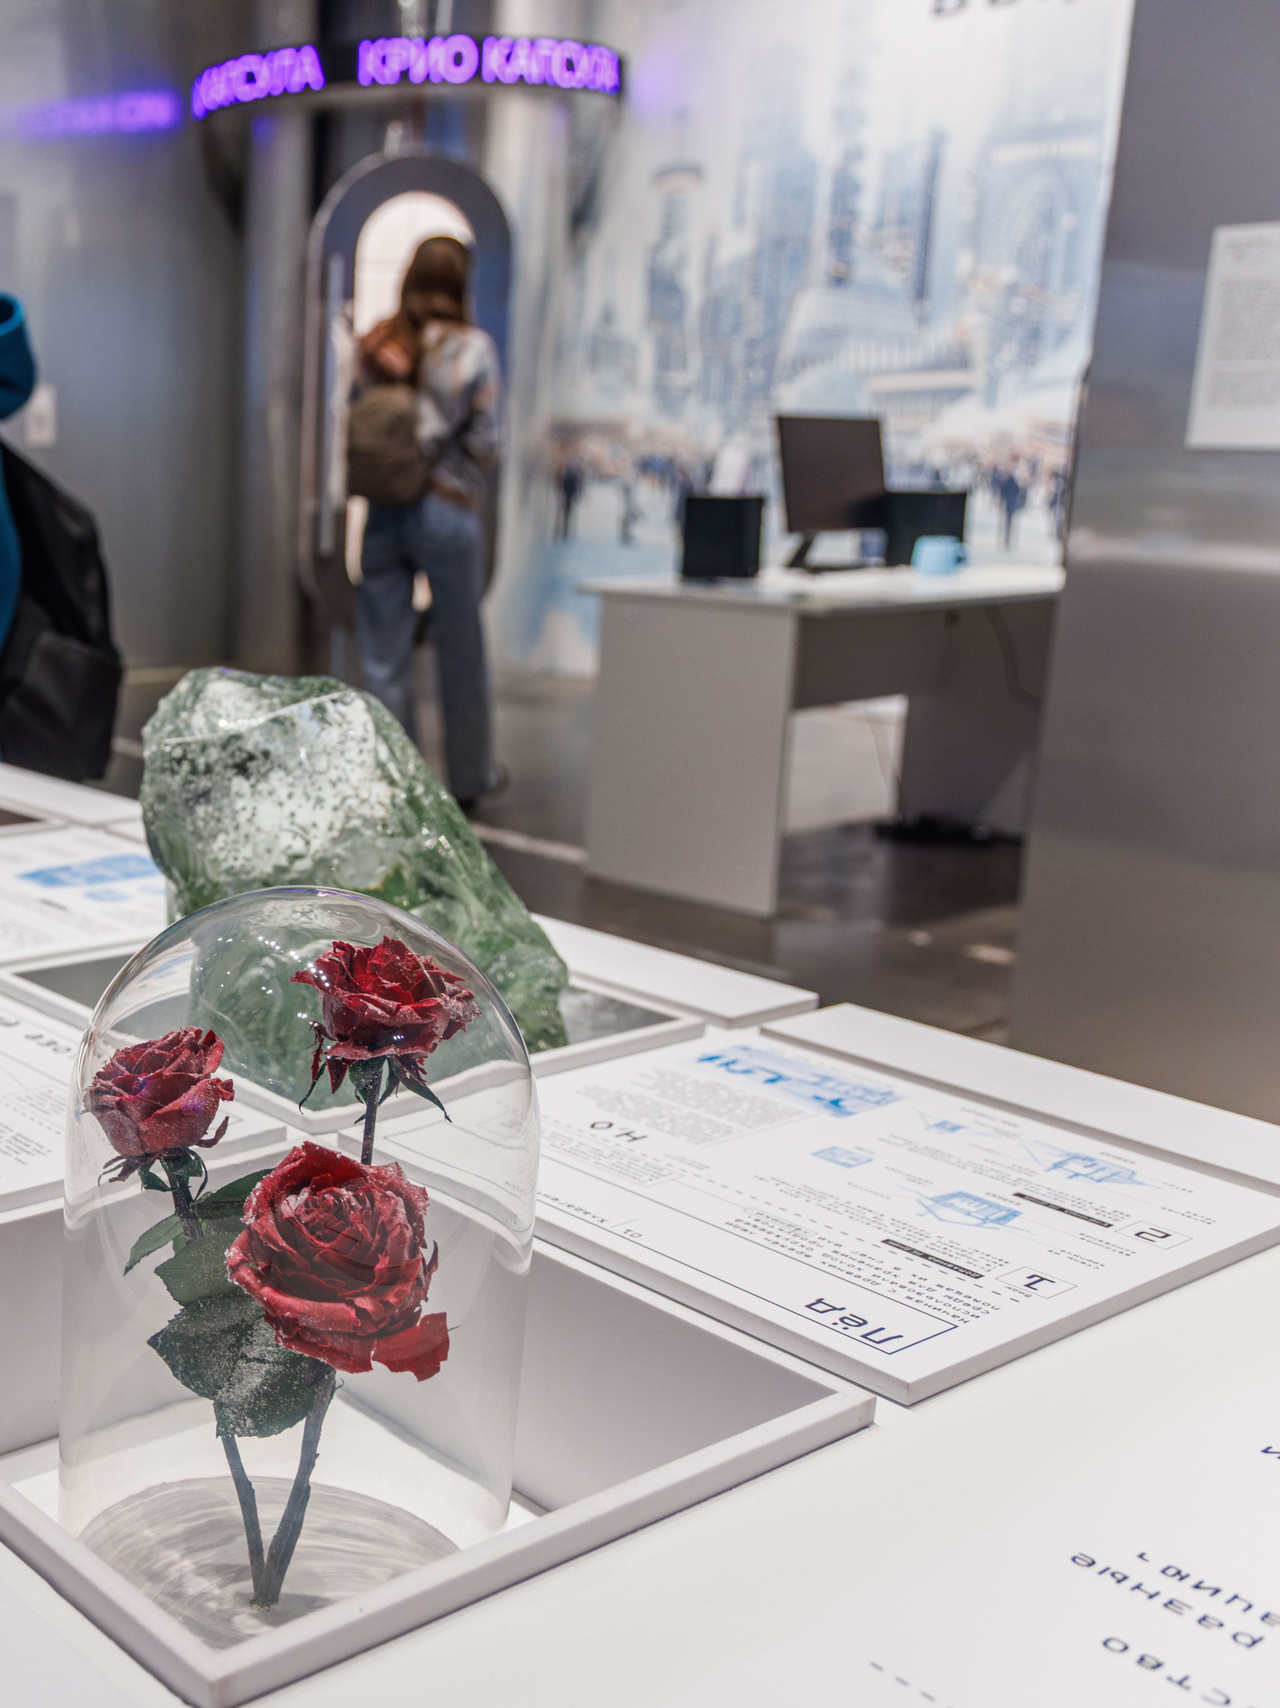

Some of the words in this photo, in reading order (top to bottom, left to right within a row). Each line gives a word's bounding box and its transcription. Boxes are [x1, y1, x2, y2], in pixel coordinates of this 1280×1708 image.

[357, 34, 480, 85] КРИО
[1133, 1226, 1172, 1243] 2
[820, 1260, 881, 1286] древних
[1022, 1273, 1056, 1291] 1
[870, 1273, 981, 1319] использовали
[904, 1294, 970, 1324] Начиная
[934, 1282, 1001, 1311] помещая
[942, 1293, 990, 1315] среды
[804, 1297, 905, 1345] Лёд
[1070, 1551, 1264, 1649] разные
[1101, 1637, 1256, 1708] ство
